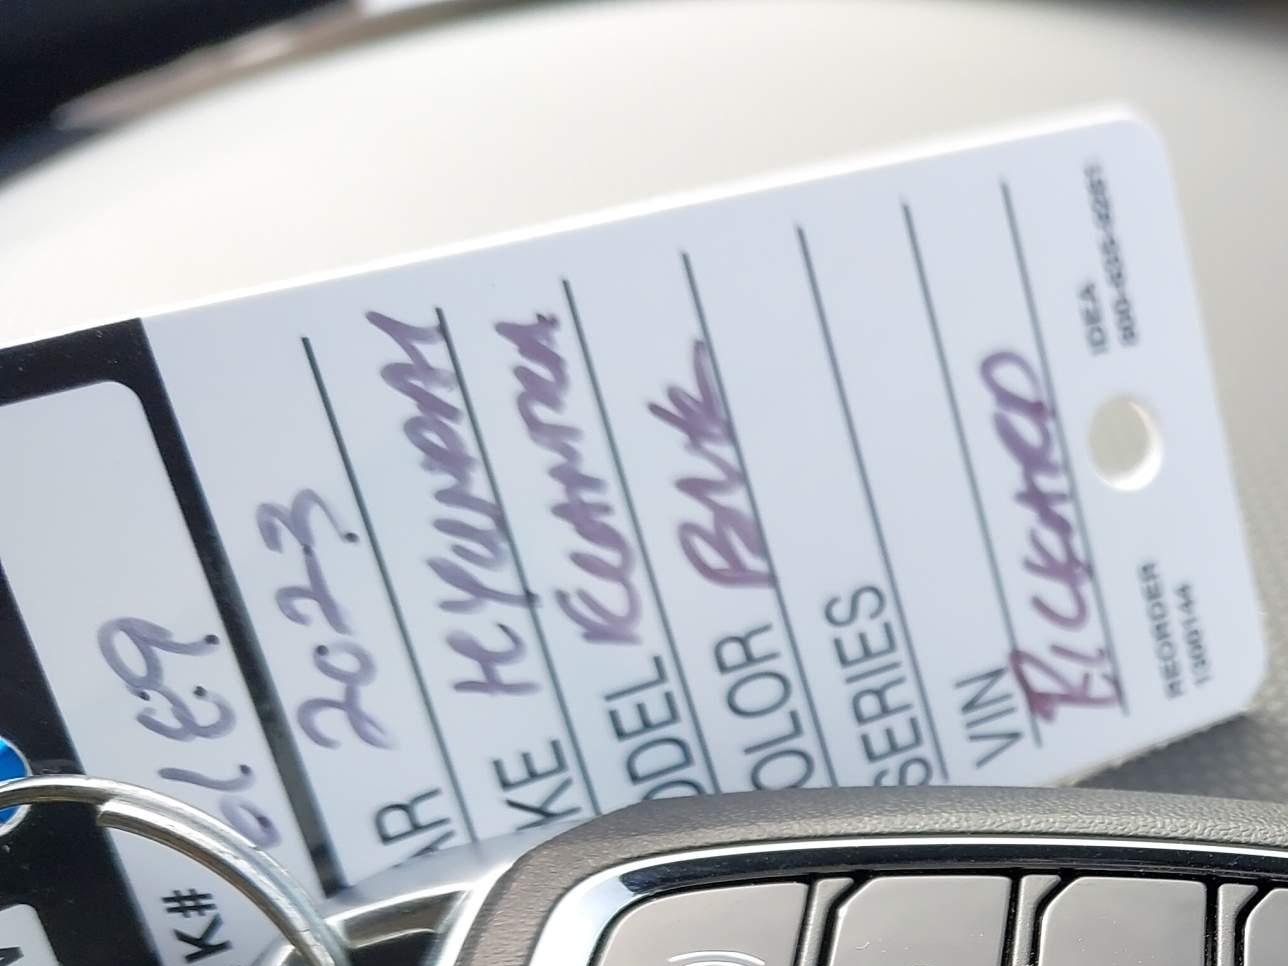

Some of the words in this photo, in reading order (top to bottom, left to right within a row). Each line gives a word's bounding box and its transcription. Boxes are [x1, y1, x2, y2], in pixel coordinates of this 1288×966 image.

[257, 488, 396, 751] 2023
[823, 584, 933, 786] SERIES
[1138, 562, 1187, 699] REORDER
[954, 667, 1025, 769] VIN
